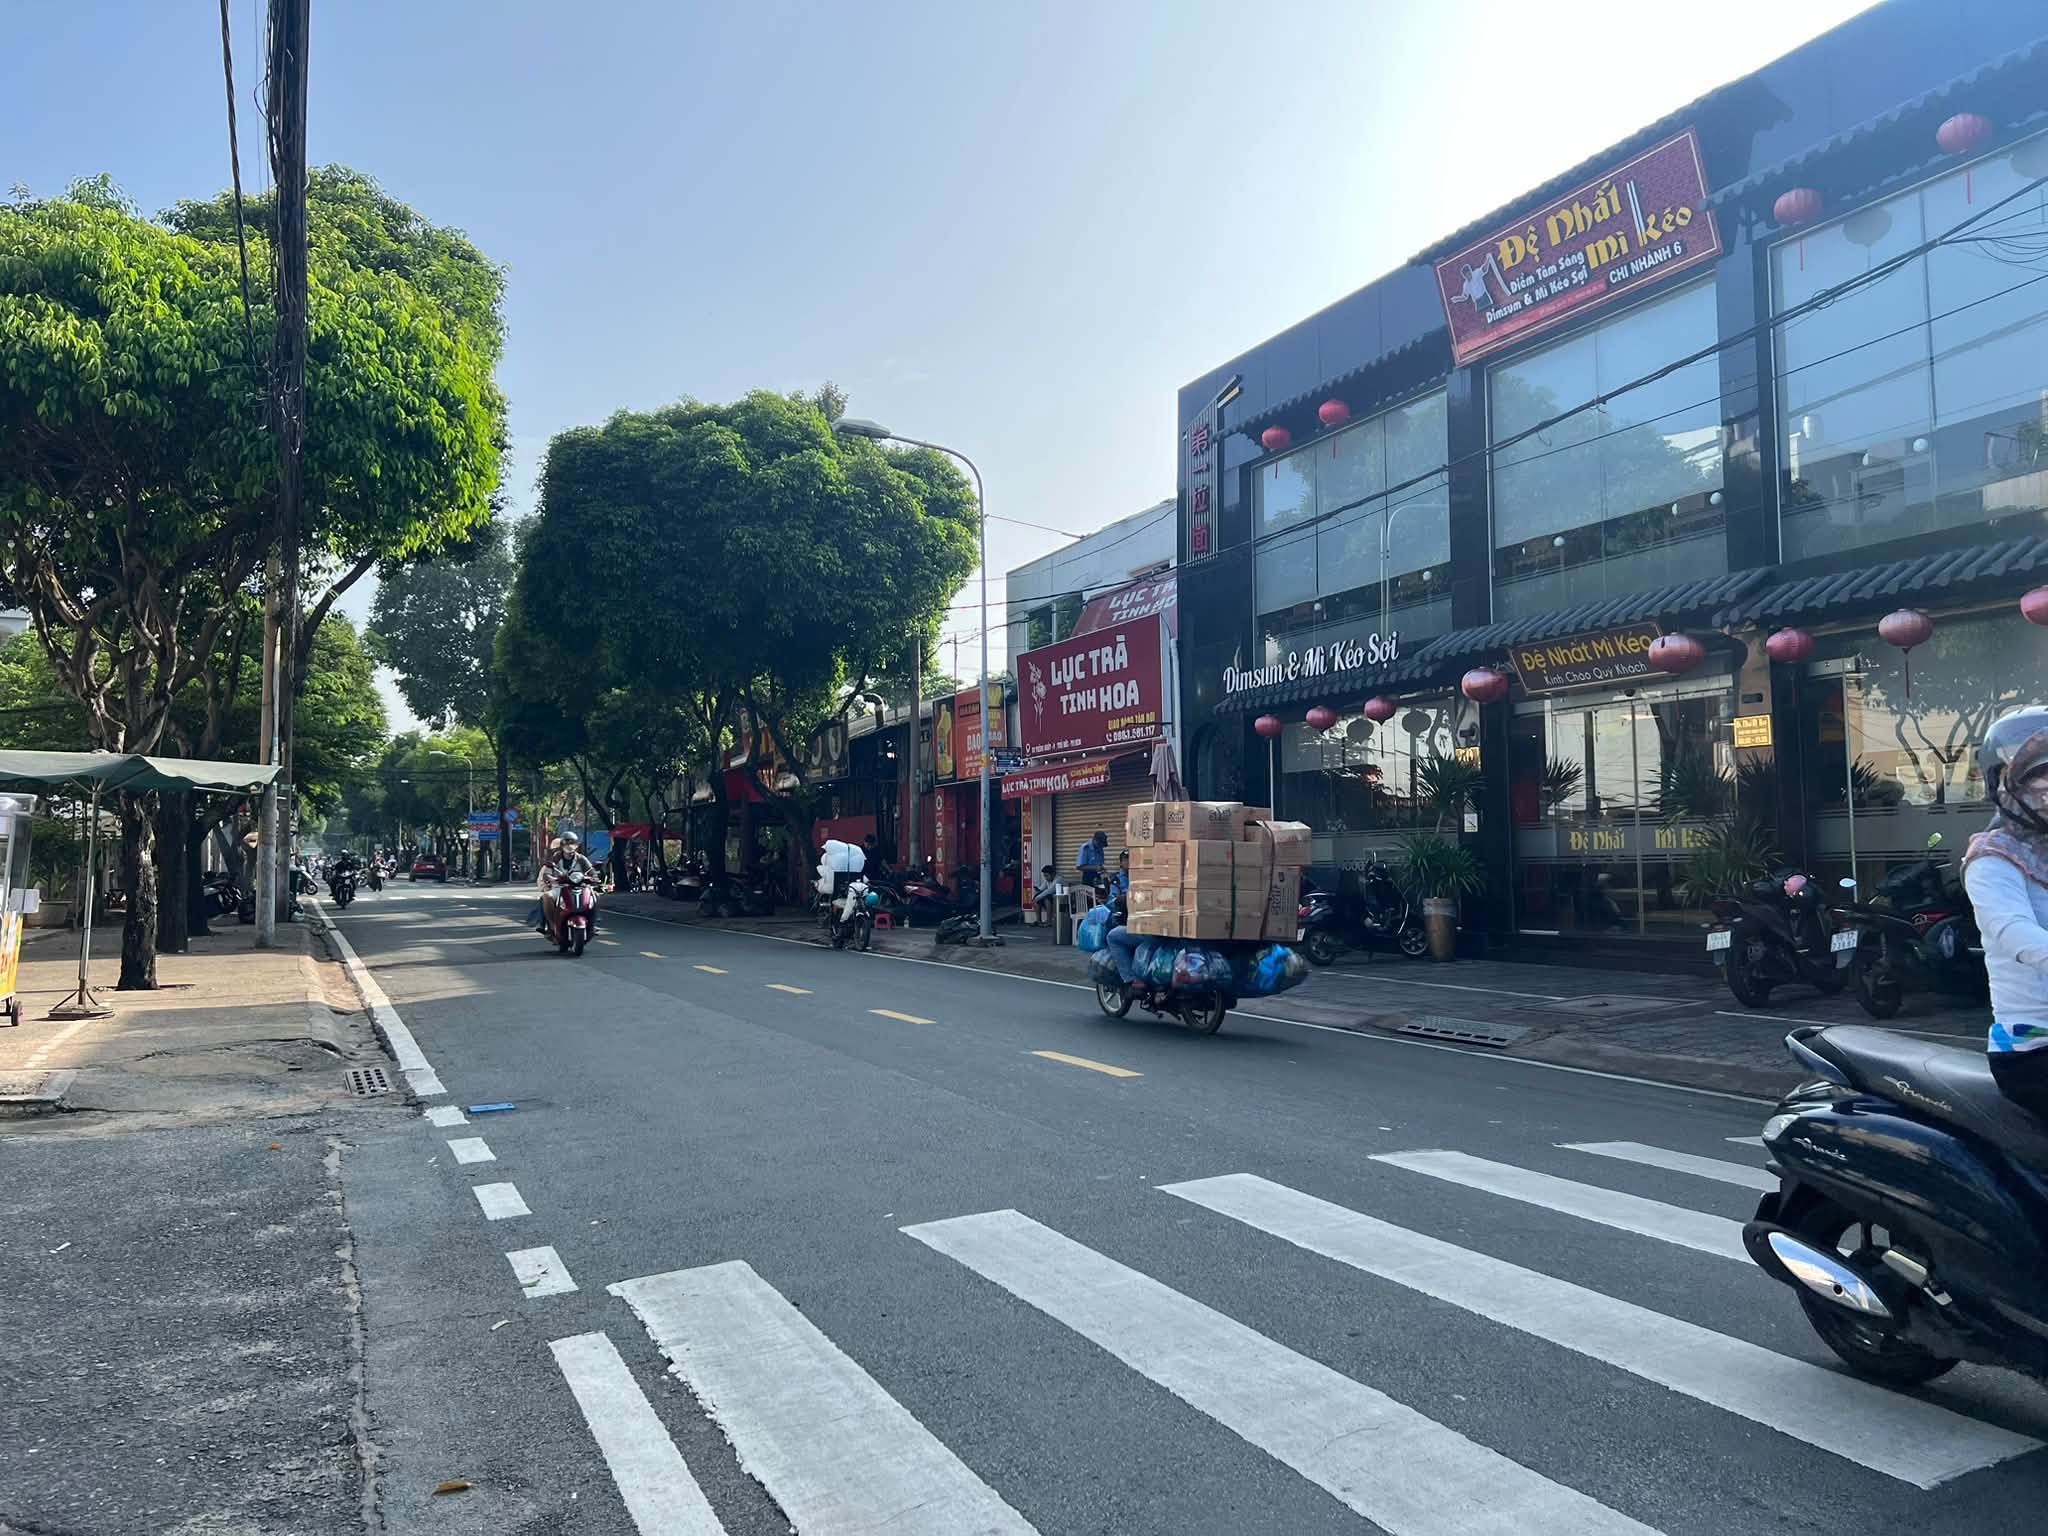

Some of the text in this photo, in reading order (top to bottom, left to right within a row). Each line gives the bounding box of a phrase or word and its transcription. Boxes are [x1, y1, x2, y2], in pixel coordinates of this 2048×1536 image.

[1497, 179, 1623, 270] Đệ Nhất
[1609, 241, 1682, 284] CHI NHÁNH 6
[1486, 301, 1522, 324] Dimsum
[1524, 293, 1533, 305] &
[1535, 285, 1549, 301] Mì
[1152, 580, 1177, 597] TR
[1051, 634, 1129, 690] LỤC TRÀ
[1223, 632, 1400, 694] Dimsum & Mì Kéo Sợi
[1521, 631, 1652, 674] Đệ Nhất Mì Kéo
[1060, 679, 1140, 715] TINH HOA
[1046, 773, 1069, 792] HOA
